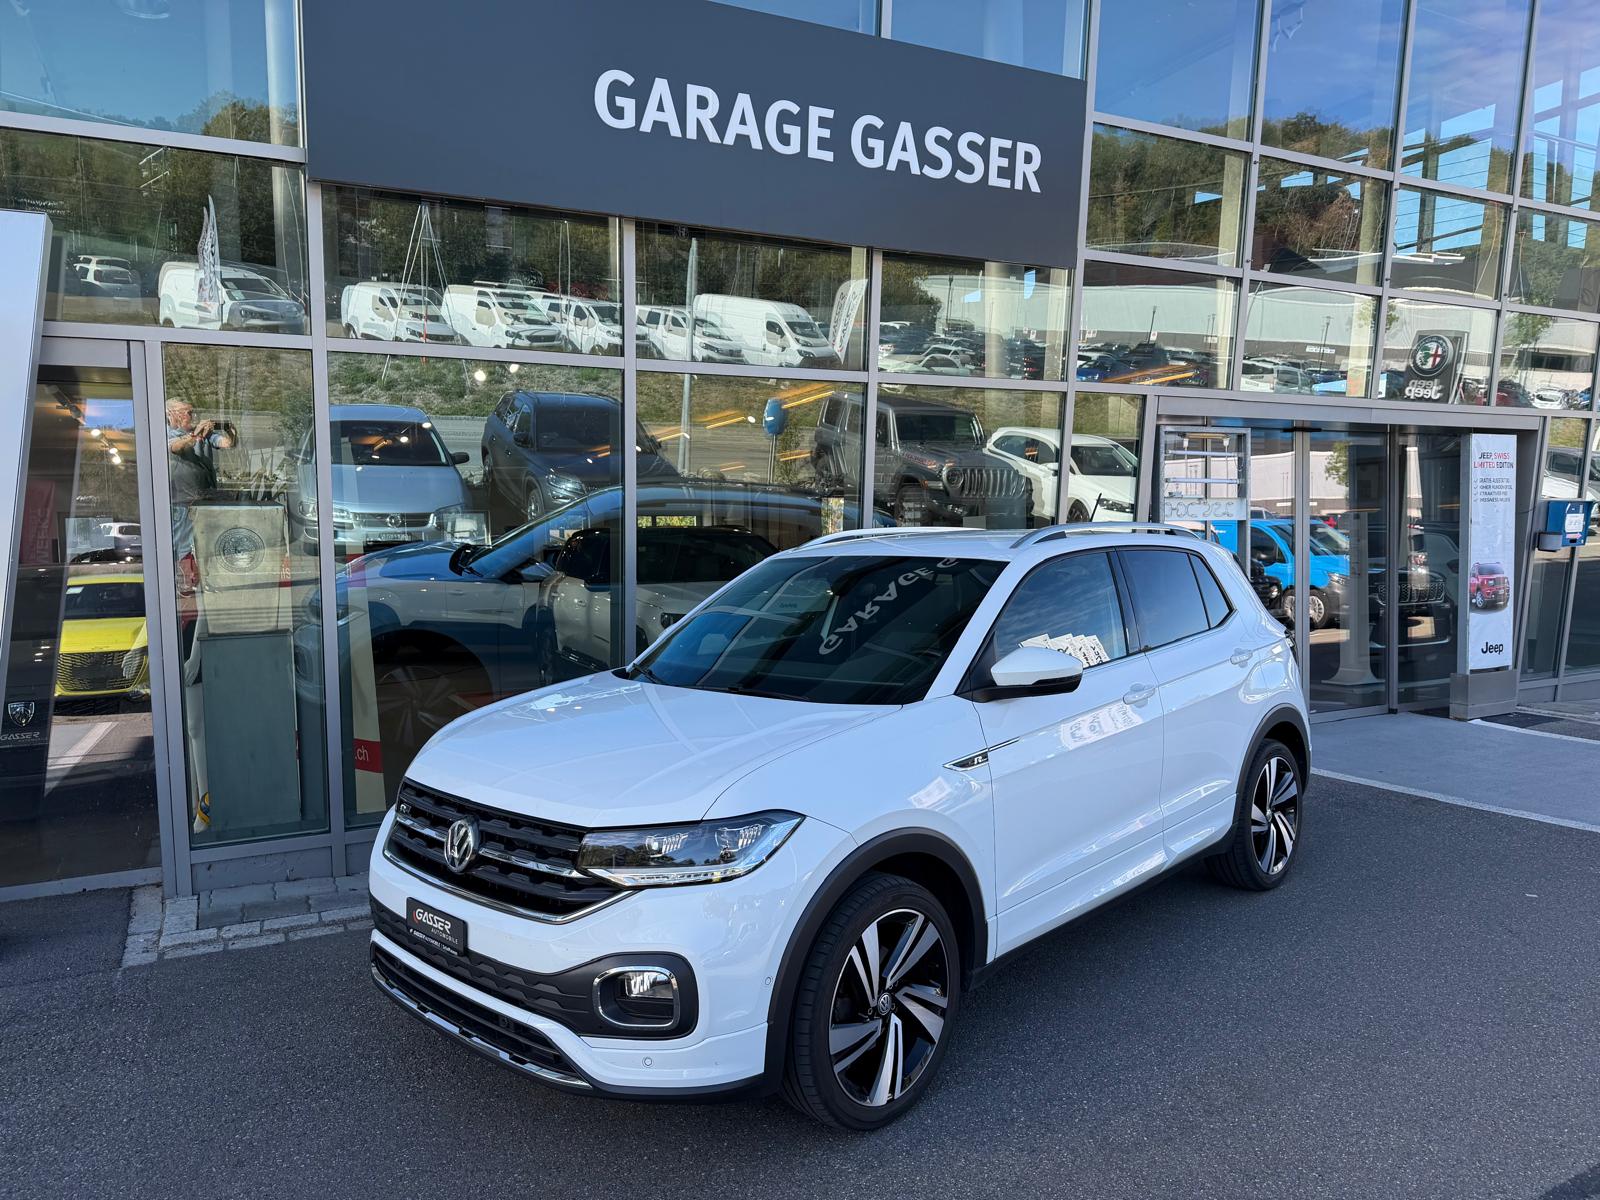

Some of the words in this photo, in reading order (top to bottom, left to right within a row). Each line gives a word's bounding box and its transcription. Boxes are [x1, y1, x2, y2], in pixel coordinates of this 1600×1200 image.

[594, 69, 835, 162] GARAGE
[850, 114, 1042, 193] GASSER
[1481, 641, 1504, 655] Jeep
[0, 731, 40, 741] GASSER
[415, 908, 452, 935] GASSER
[431, 927, 459, 945] AUTOMOBILE
